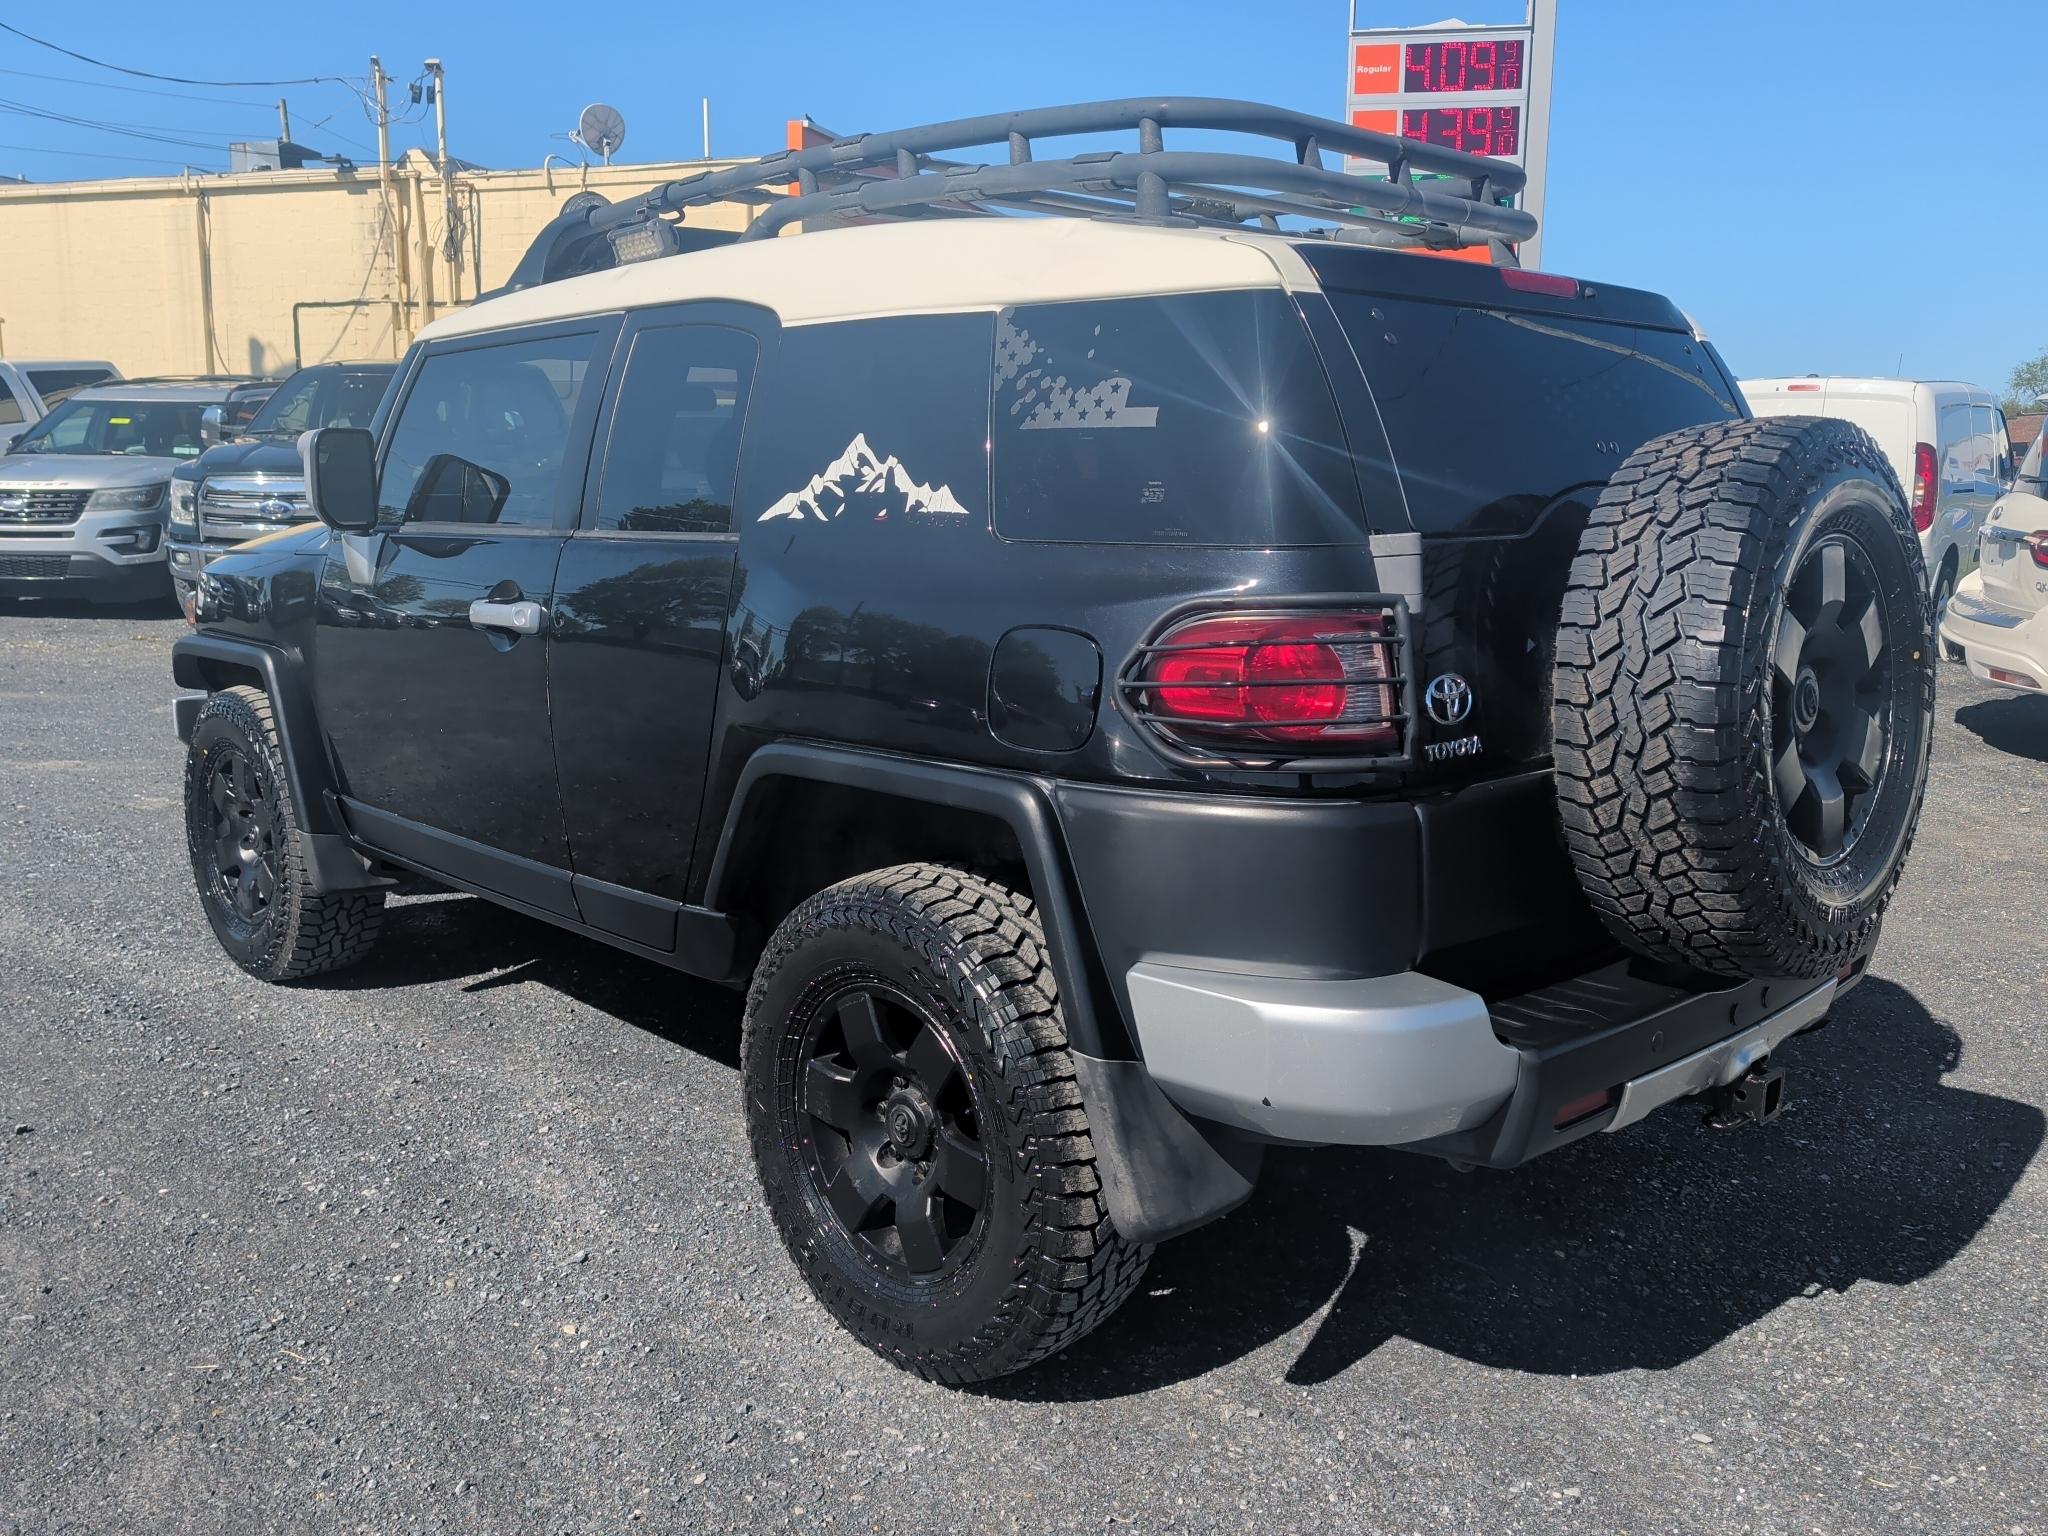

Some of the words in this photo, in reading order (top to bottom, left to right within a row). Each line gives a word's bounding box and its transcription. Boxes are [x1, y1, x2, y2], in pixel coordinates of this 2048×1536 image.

[1357, 65, 1392, 74] Regular
[1405, 41, 1497, 92] 4.09
[1403, 107, 1494, 157] 439
[1424, 736, 1483, 761] TOYOTA
